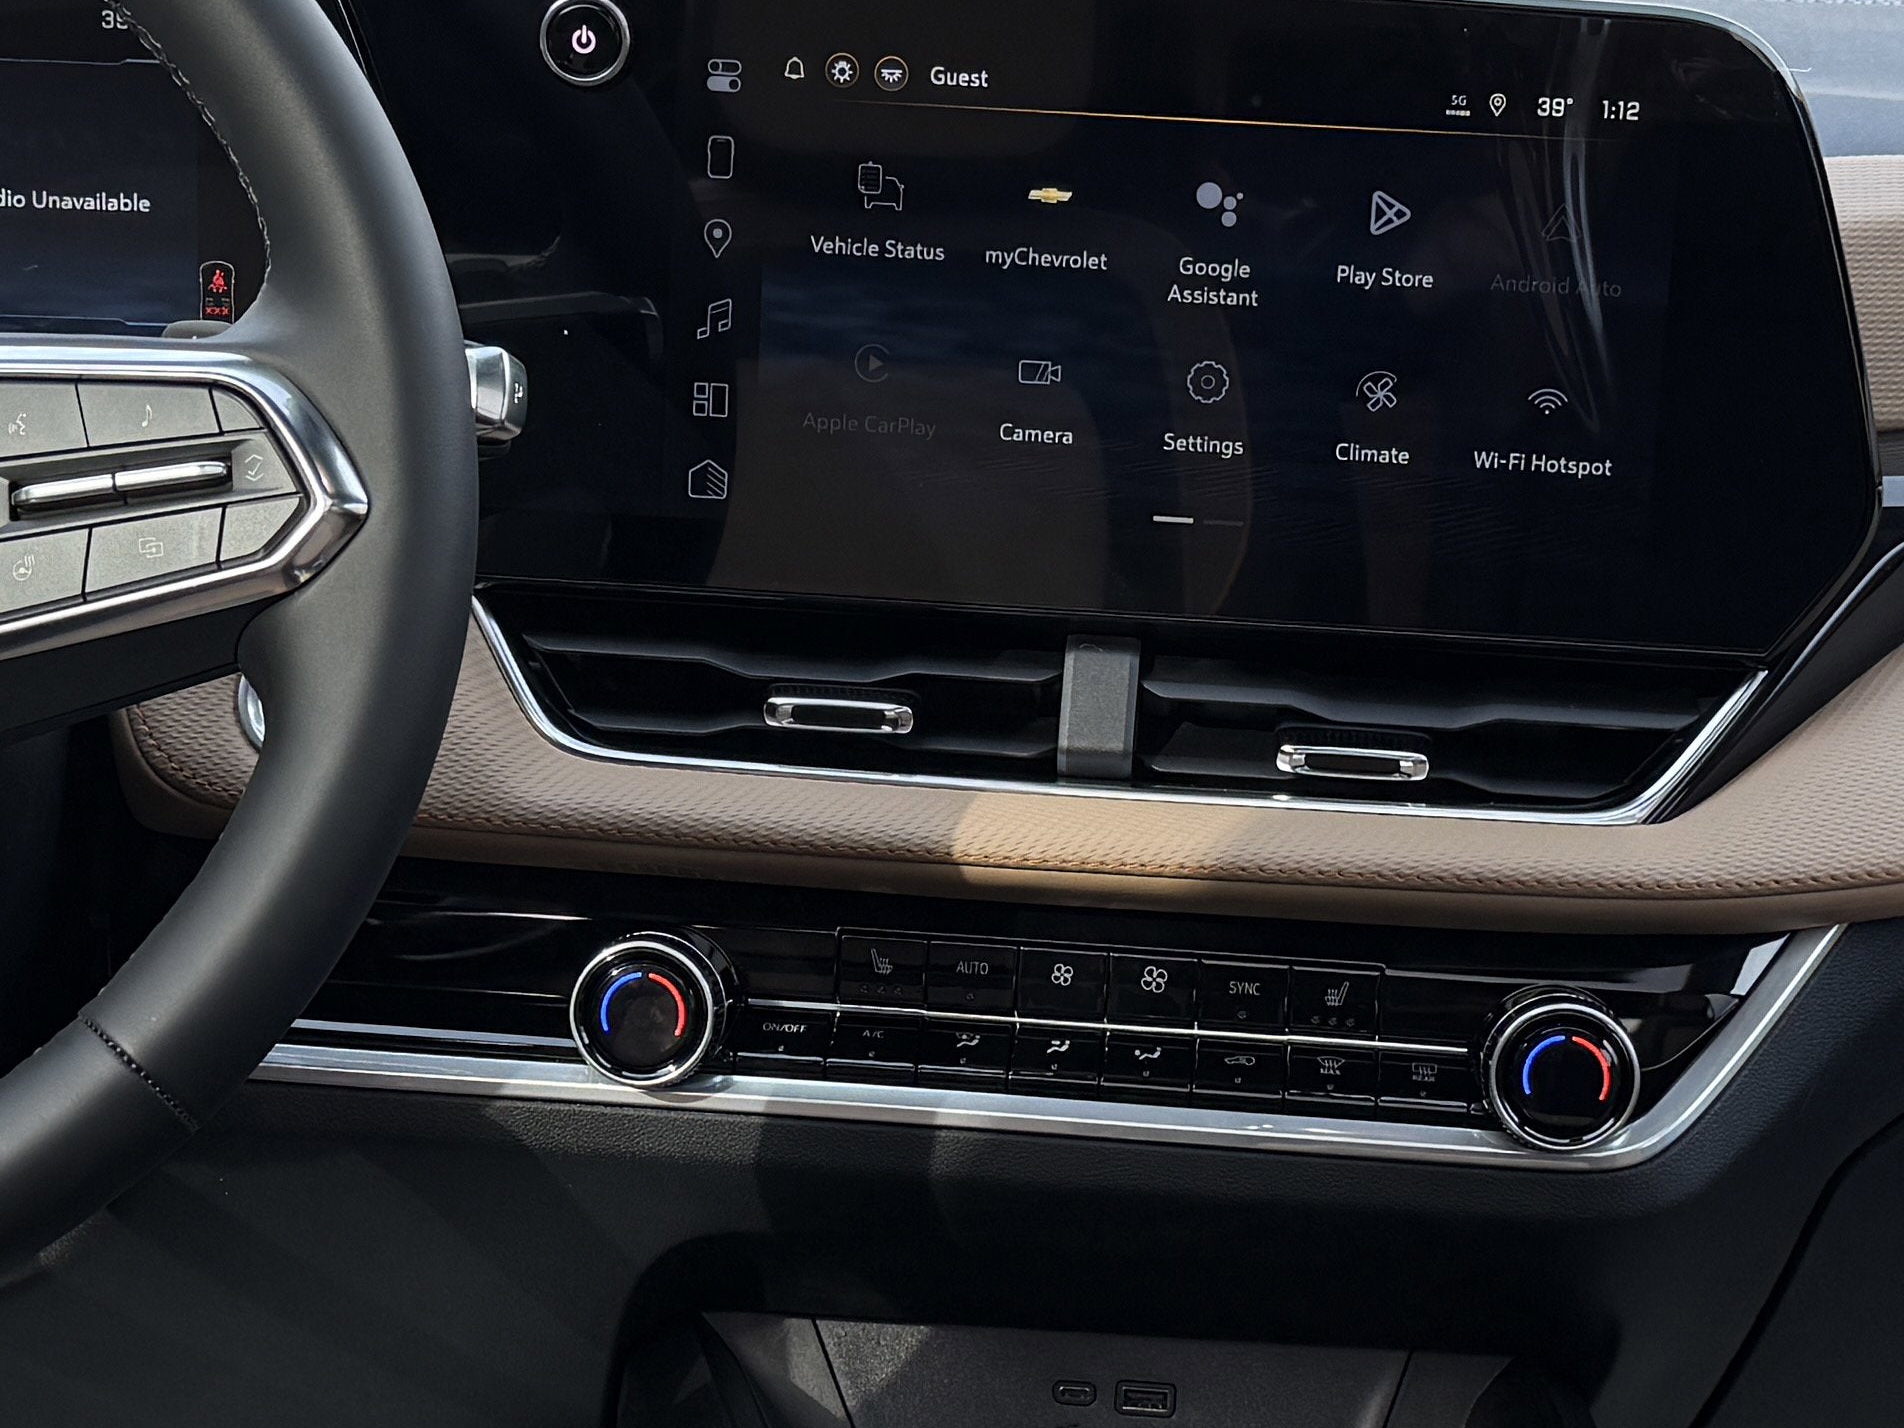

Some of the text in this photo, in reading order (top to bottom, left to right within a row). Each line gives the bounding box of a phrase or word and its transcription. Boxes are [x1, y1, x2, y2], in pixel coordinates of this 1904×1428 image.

[930, 66, 989, 88] Guest
[1537, 97, 1574, 117] 39°
[1602, 100, 1640, 121] 1:12
[32, 191, 151, 213] Unavailable
[810, 235, 946, 261] Vehicle Status
[985, 247, 1108, 272] myChevrolet
[1179, 256, 1251, 283] Google
[1336, 264, 1434, 290] Play Store
[1167, 284, 1259, 307] Assistant
[1490, 274, 1570, 295] Android
[802, 412, 937, 441] Apple CarPlay
[999, 422, 1073, 446] Camera
[1163, 432, 1244, 459] Settings
[1335, 443, 1410, 465] Climate
[1474, 450, 1613, 479] Wi-Fi Hotspot
[956, 960, 989, 975] AUTO
[1229, 981, 1261, 996] SYNC
[762, 1022, 808, 1034] ON/OFF
